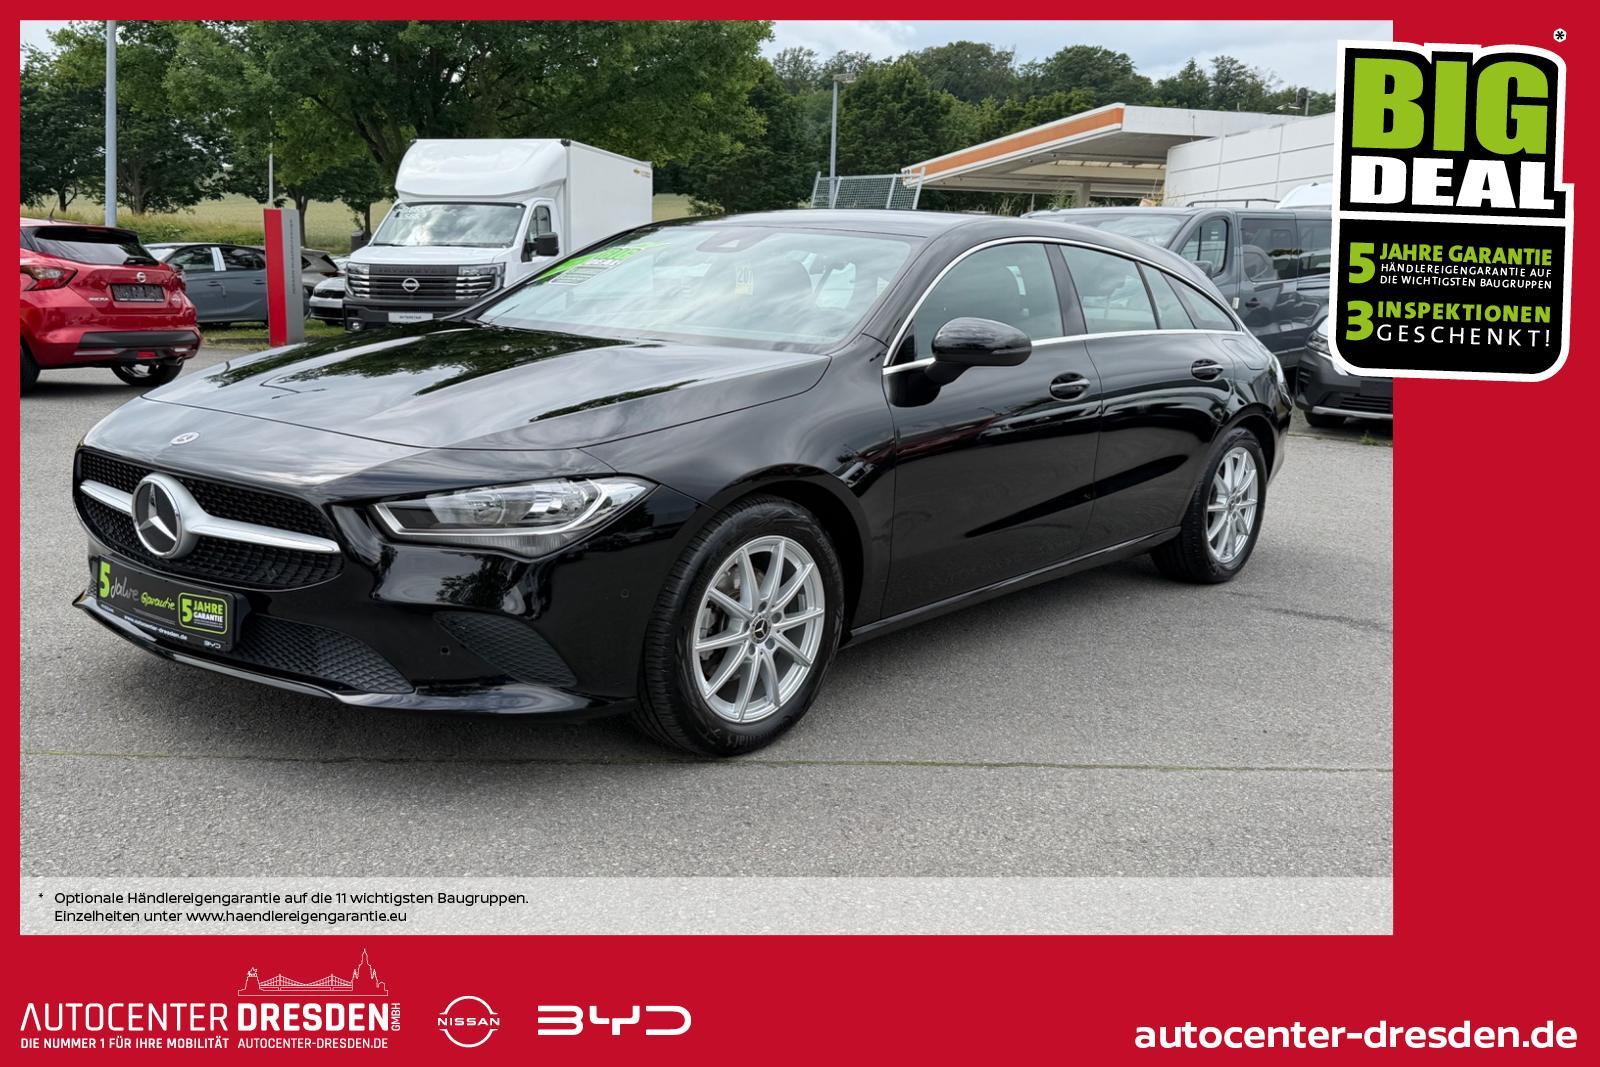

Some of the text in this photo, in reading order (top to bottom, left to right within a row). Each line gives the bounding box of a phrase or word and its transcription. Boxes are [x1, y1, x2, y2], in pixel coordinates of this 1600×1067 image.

[99, 560, 111, 599] 5
[110, 576, 139, 600] Jahre
[140, 591, 176, 611] Garantie
[181, 598, 193, 623] 5
[193, 600, 224, 615] JAHRE
[193, 610, 224, 623] GARANTIE
